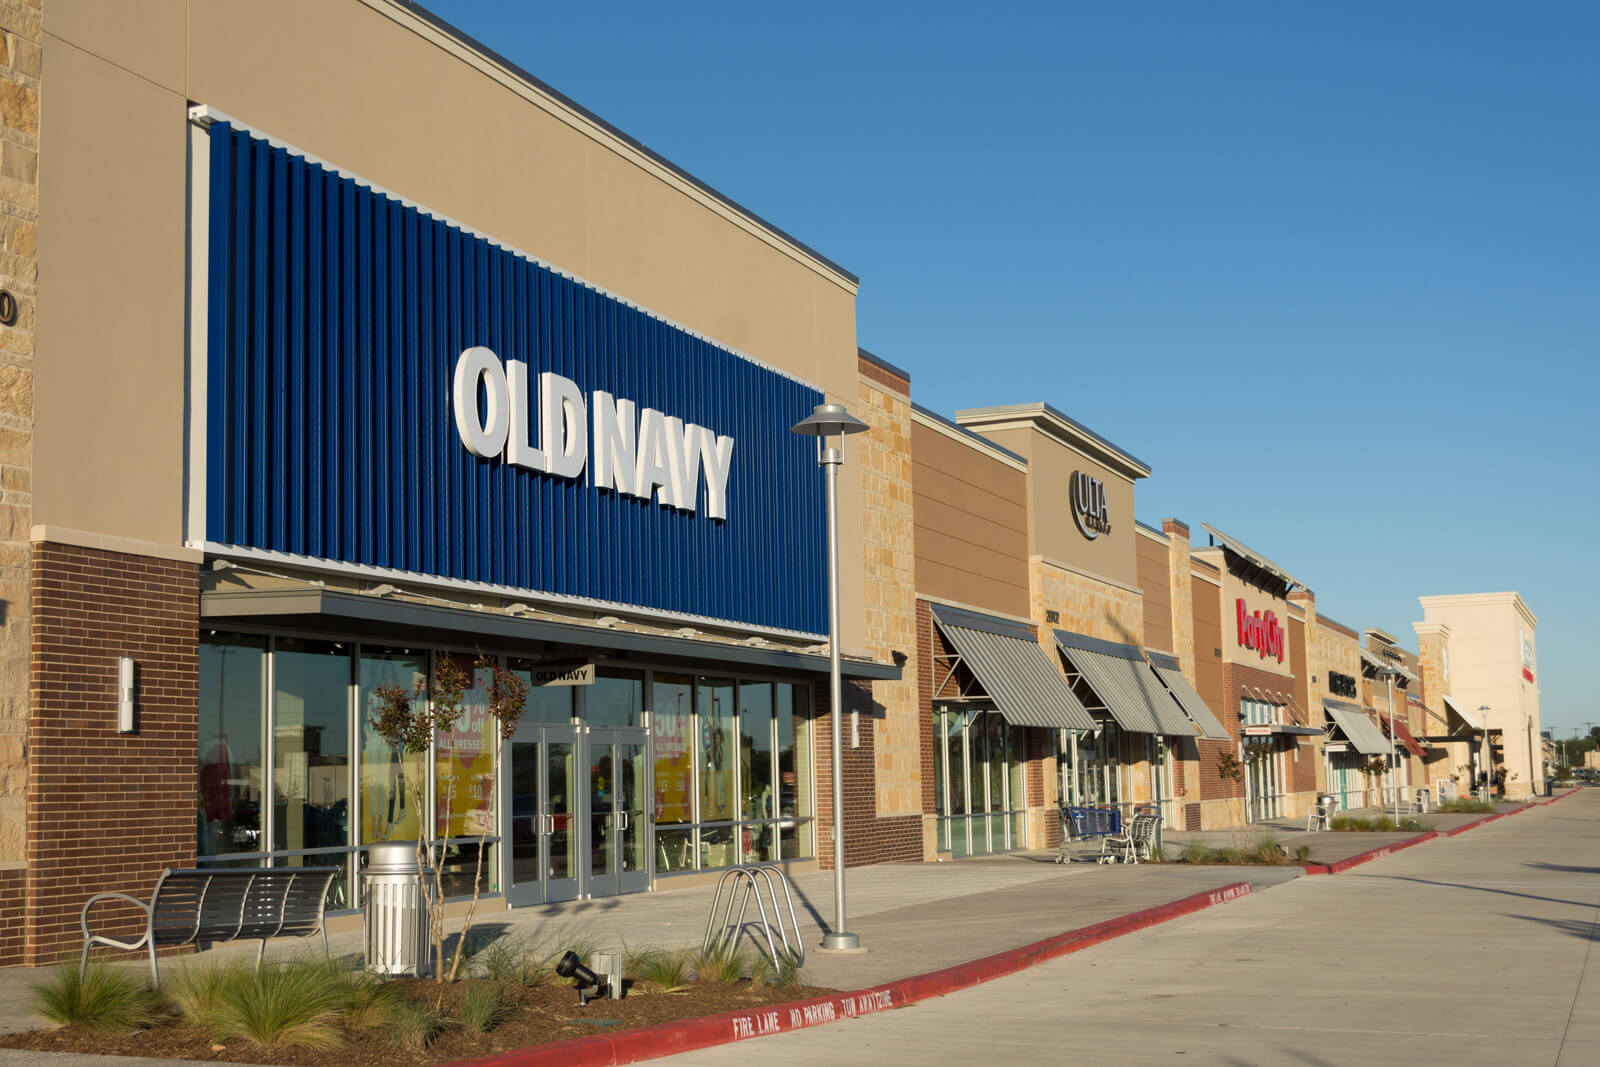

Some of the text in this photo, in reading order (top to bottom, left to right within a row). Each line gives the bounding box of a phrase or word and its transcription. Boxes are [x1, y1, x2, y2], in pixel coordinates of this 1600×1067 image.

[453, 346, 734, 520] OLD NAVY
[1076, 471, 1109, 521] ULTA
[536, 669, 588, 681] OLD NAVY
[471, 718, 485, 733] off
[732, 1017, 755, 1040] FIRE
[756, 1011, 780, 1034] LANE
[789, 1009, 802, 1028] NO
[803, 1001, 836, 1024] PARKING
[841, 997, 857, 1017] TOW
